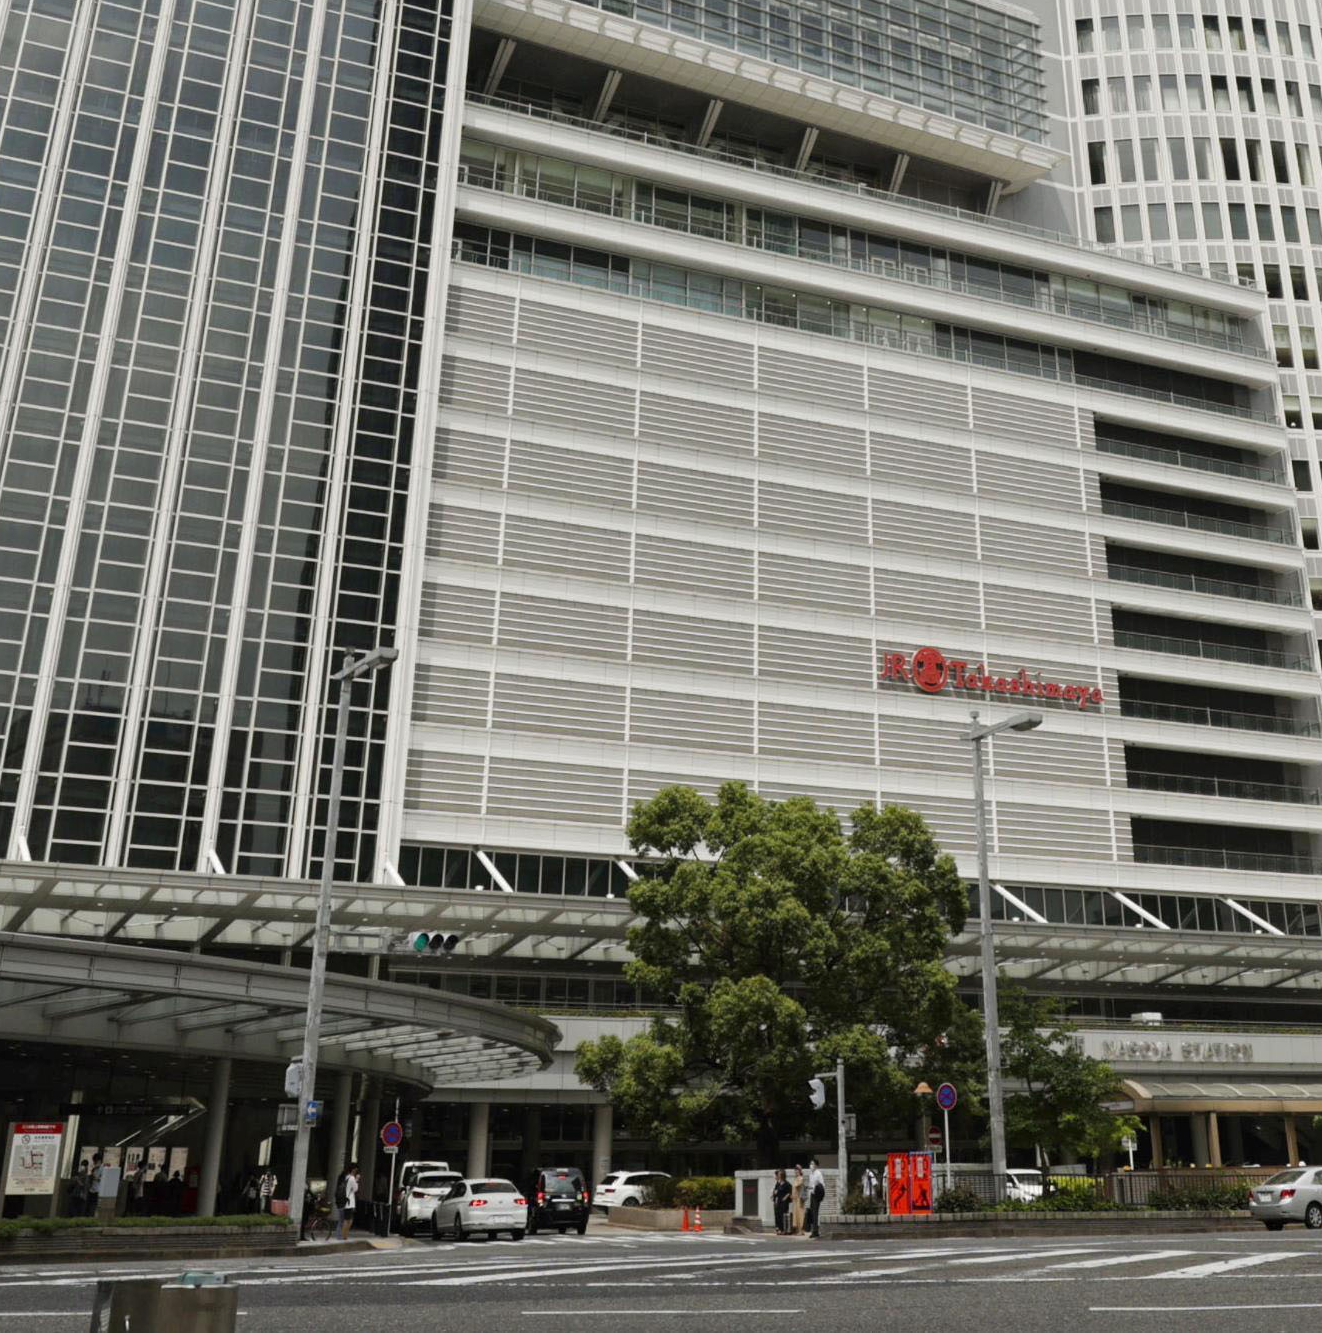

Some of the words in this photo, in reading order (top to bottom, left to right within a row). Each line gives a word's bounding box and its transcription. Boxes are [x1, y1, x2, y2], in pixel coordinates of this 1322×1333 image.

[882, 651, 909, 680] JR
[949, 661, 1104, 707] Takashimaya
[1103, 1041, 1172, 1061] NAGOYA
[1181, 1042, 1254, 1062] STATION
